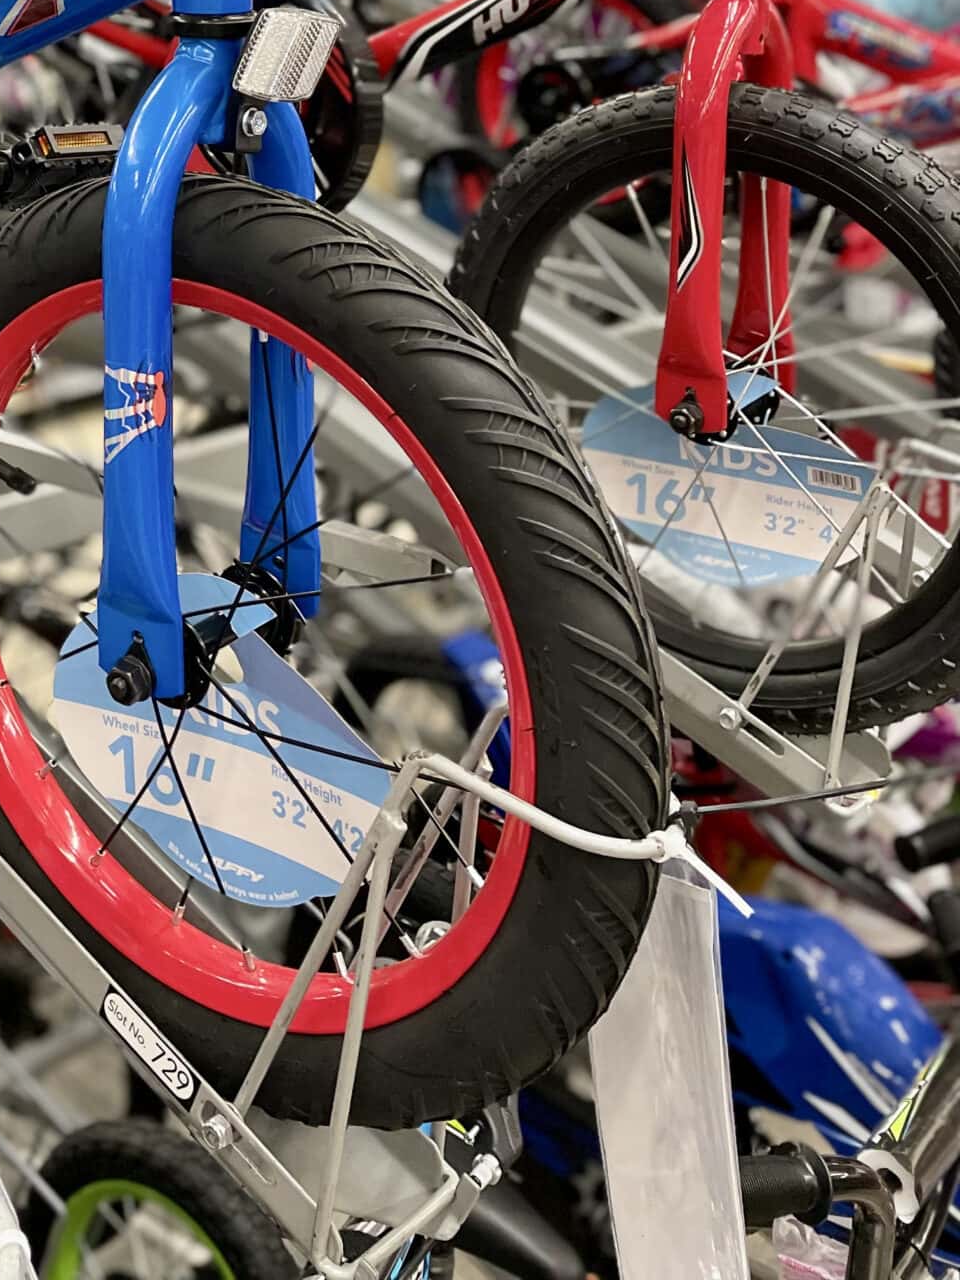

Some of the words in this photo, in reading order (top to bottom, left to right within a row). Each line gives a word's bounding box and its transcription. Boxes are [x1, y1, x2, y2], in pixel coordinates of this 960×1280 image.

[102, 714, 140, 734] Wheel
[143, 723, 161, 739] Siz
[108, 734, 216, 807] 16"
[303, 779, 343, 807] Height
[107, 999, 128, 1027] Slot
[128, 1021, 147, 1049] No.
[151, 1042, 190, 1090] 729
